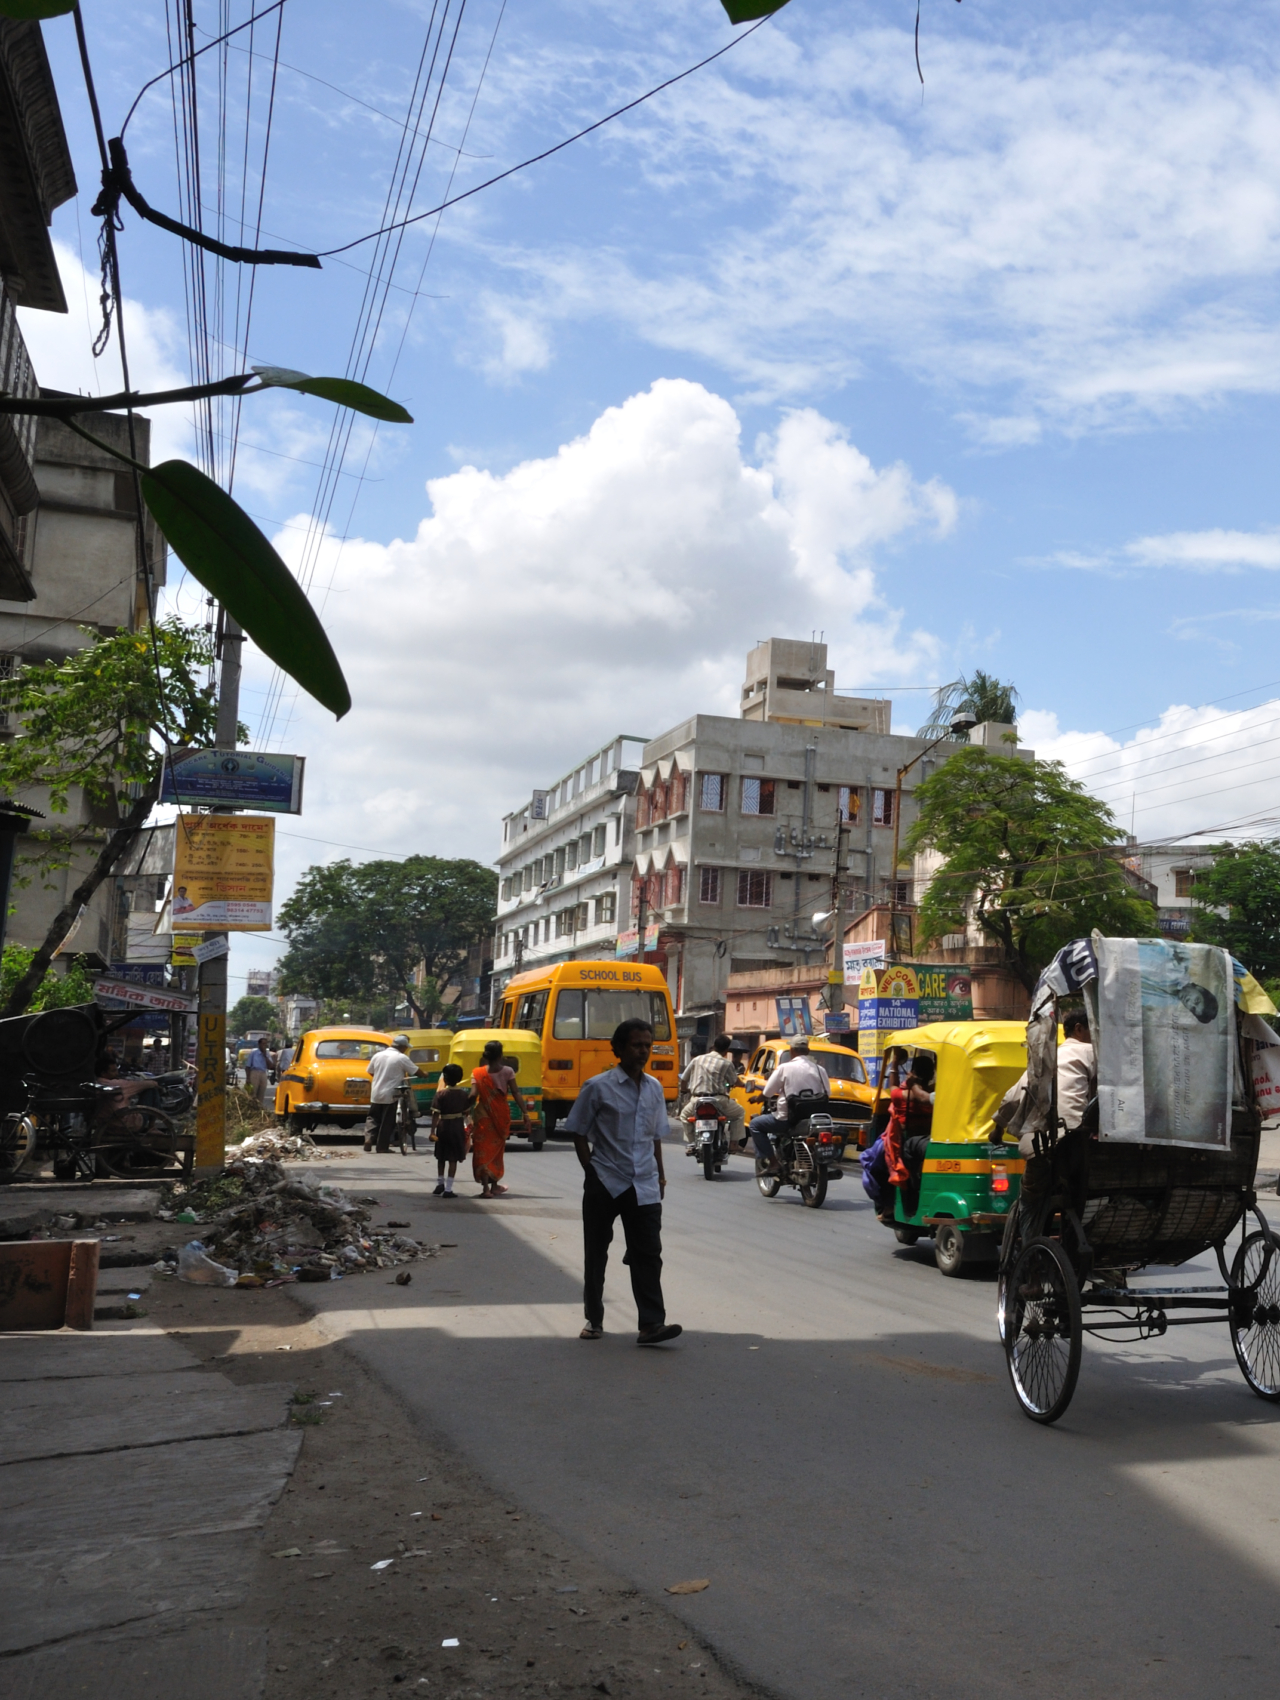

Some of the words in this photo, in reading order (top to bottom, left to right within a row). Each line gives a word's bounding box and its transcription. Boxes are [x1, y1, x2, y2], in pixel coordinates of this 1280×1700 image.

[210, 750, 252, 760] TUTORIAL
[580, 969, 620, 981] SCHOOL
[622, 971, 642, 982] BUS
[880, 970, 916, 994] WELCOME
[917, 972, 947, 998] CARE
[879, 1007, 916, 1017] NATIONAL
[877, 1018, 917, 1028] EXHIBITION
[202, 1017, 218, 1083] ULTRA
[936, 1160, 961, 1172] LPG
